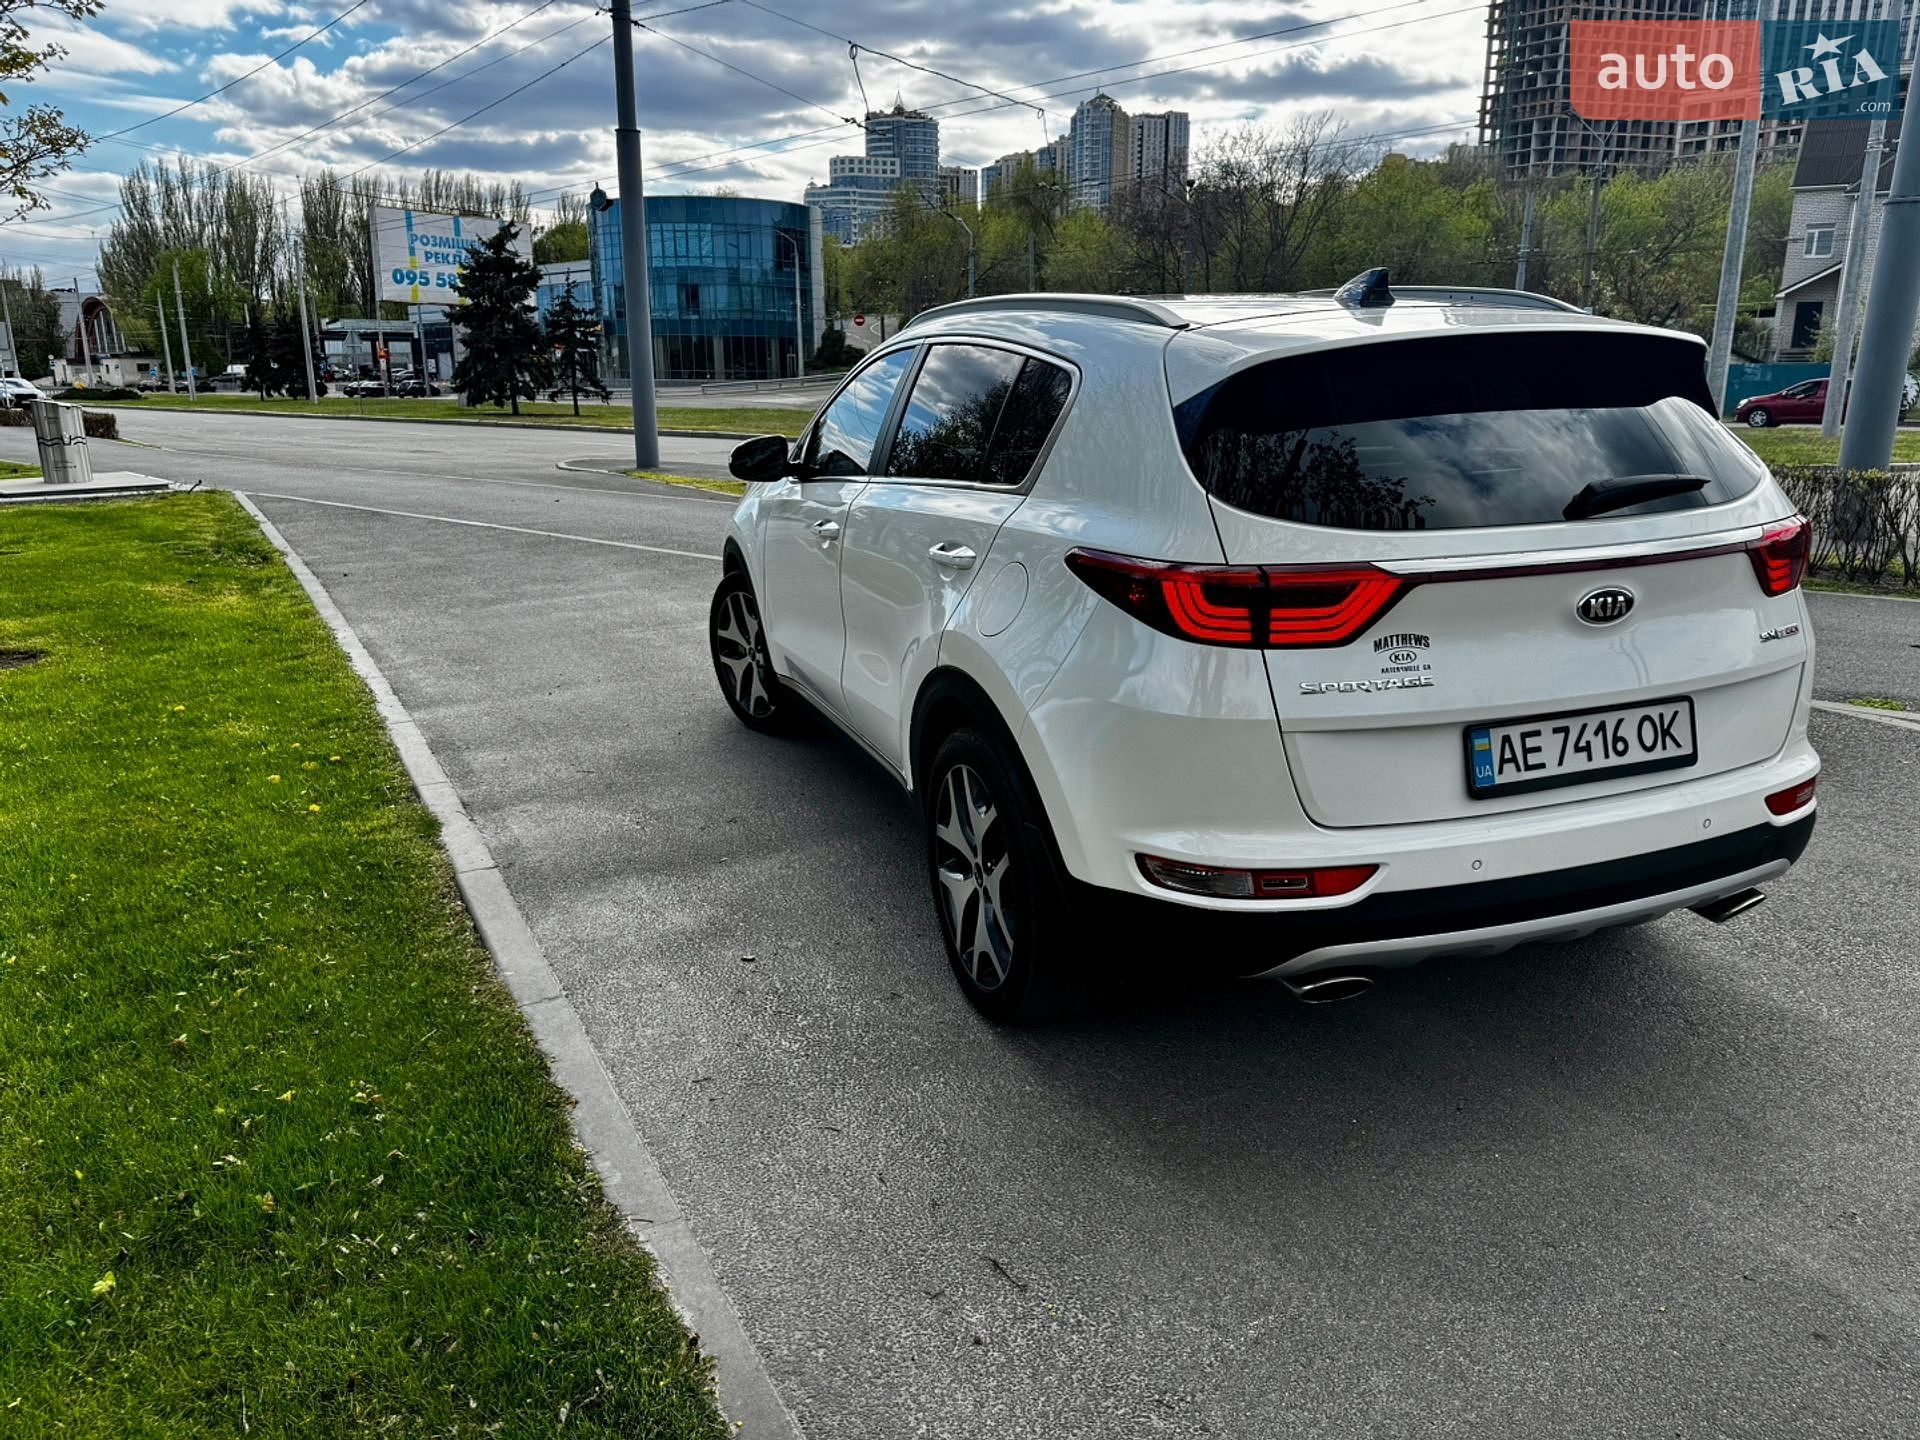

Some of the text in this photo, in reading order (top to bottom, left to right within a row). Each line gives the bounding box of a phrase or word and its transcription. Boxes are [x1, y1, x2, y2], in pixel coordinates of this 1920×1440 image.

[424, 250, 472, 265] РЕКЛА
[392, 268, 458, 288] 095 58
[1589, 595, 1627, 618] KIA
[1373, 633, 1431, 653] MATTHEWS
[1393, 652, 1413, 662] KIA
[1299, 675, 1434, 695] SPORTAGE
[1497, 710, 1683, 776] AE 7416 OK
[1476, 764, 1494, 779] UA
